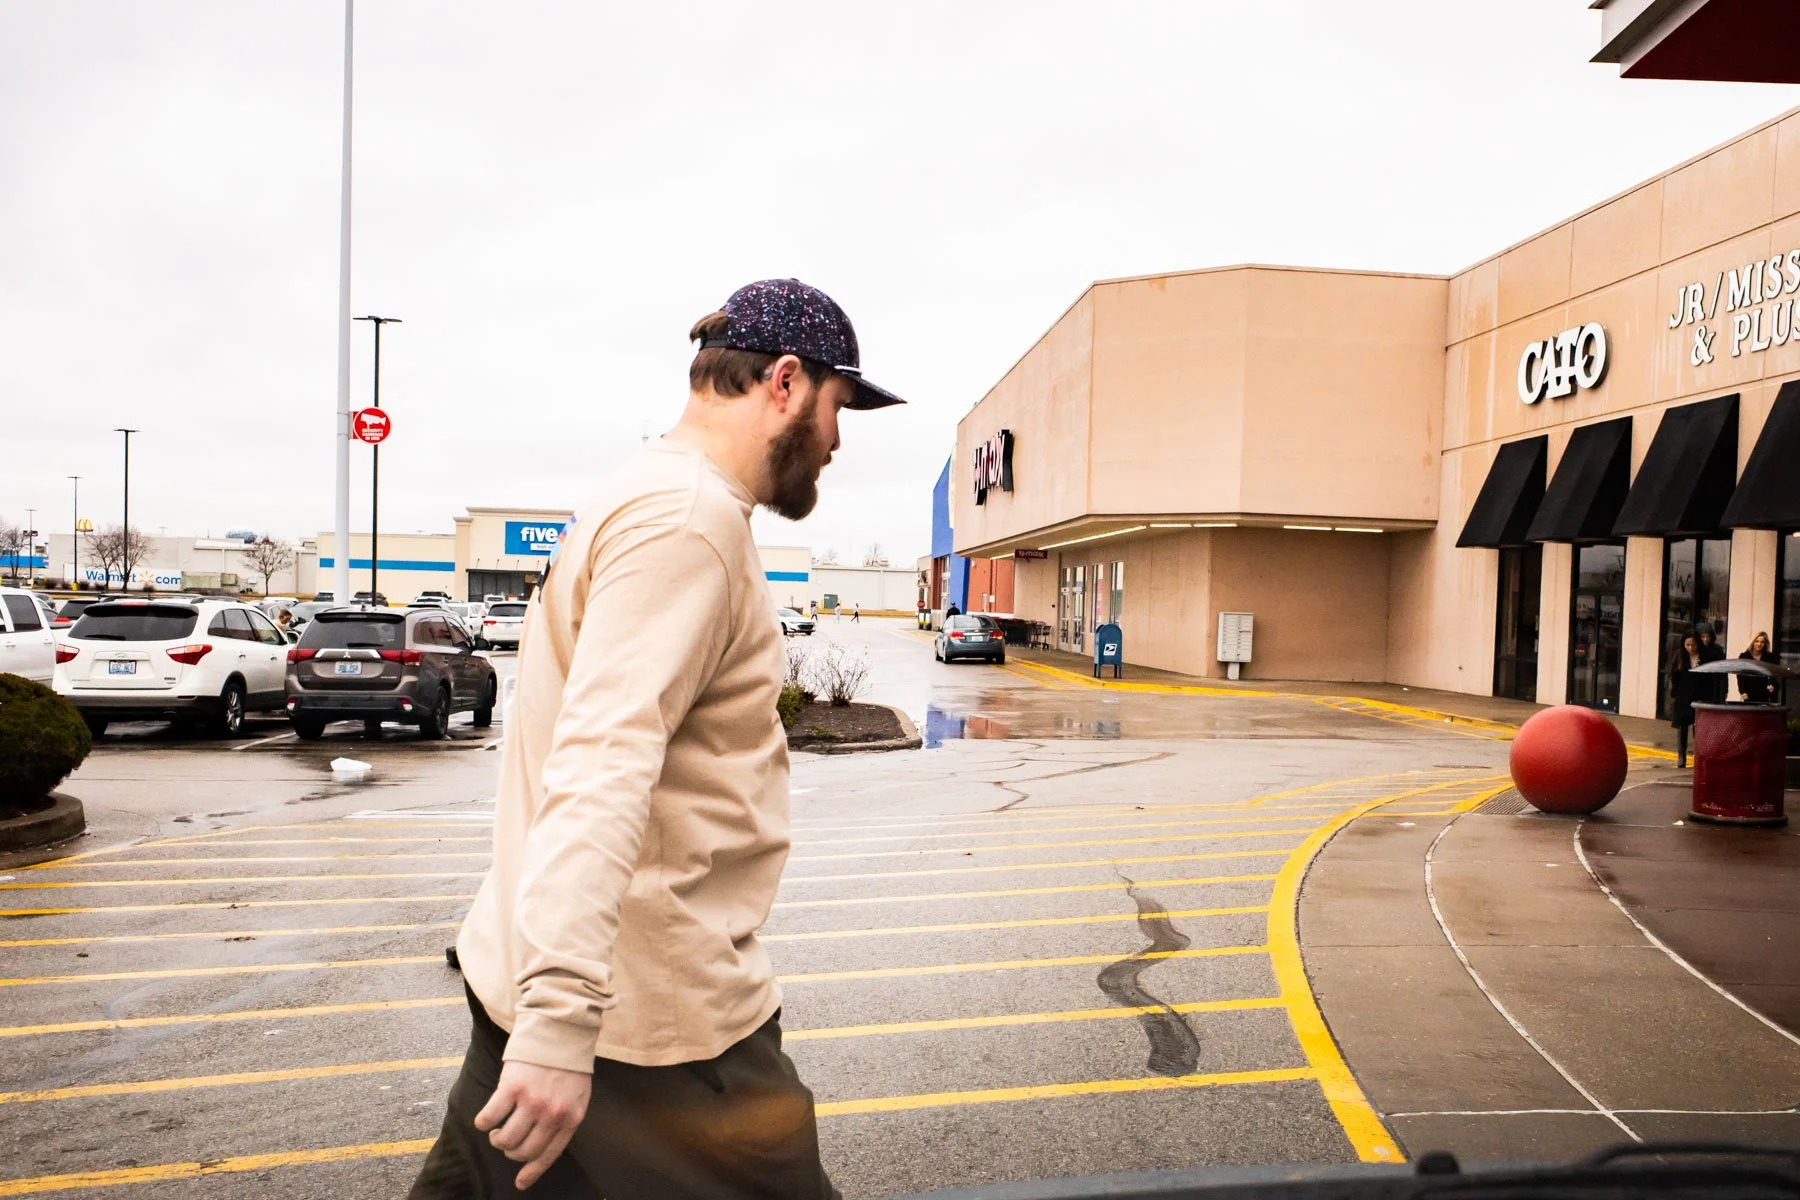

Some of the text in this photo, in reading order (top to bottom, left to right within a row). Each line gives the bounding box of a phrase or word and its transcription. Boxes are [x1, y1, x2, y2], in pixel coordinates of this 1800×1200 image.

[1518, 321, 1609, 405] CATO
[1690, 326, 1716, 367] &
[520, 527, 559, 542] five
